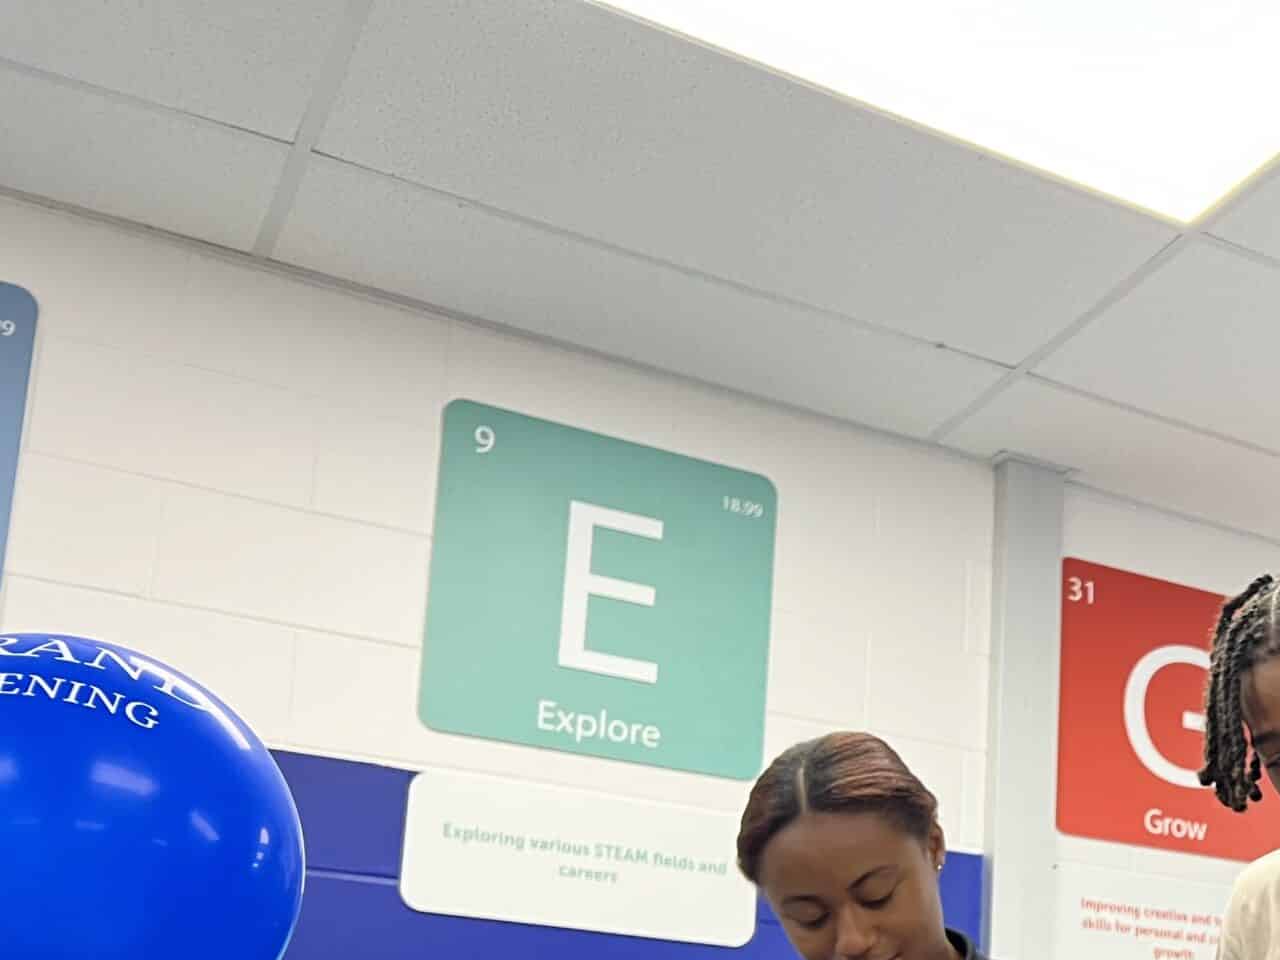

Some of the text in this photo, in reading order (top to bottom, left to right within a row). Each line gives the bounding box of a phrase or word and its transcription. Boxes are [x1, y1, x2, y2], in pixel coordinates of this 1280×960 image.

[474, 426, 495, 453] 9
[722, 496, 763, 519] 18.99
[558, 500, 664, 685] E
[1068, 577, 1095, 605] 31
[0, 673, 159, 729] ENING
[537, 699, 661, 749] Explore
[1124, 644, 1217, 789] G
[1144, 808, 1208, 841] Grow
[442, 823, 728, 876] Exploring various STEAM fields and
[558, 865, 618, 883] careers
[1081, 897, 1141, 919] Improving
[1144, 908, 1187, 922] creative
[1192, 915, 1212, 925] and
[1082, 918, 1113, 931] skills
[1115, 920, 1131, 932] for
[1135, 926, 1184, 941] personal
[1186, 933, 1206, 944] and
[1153, 947, 1195, 960] growth
